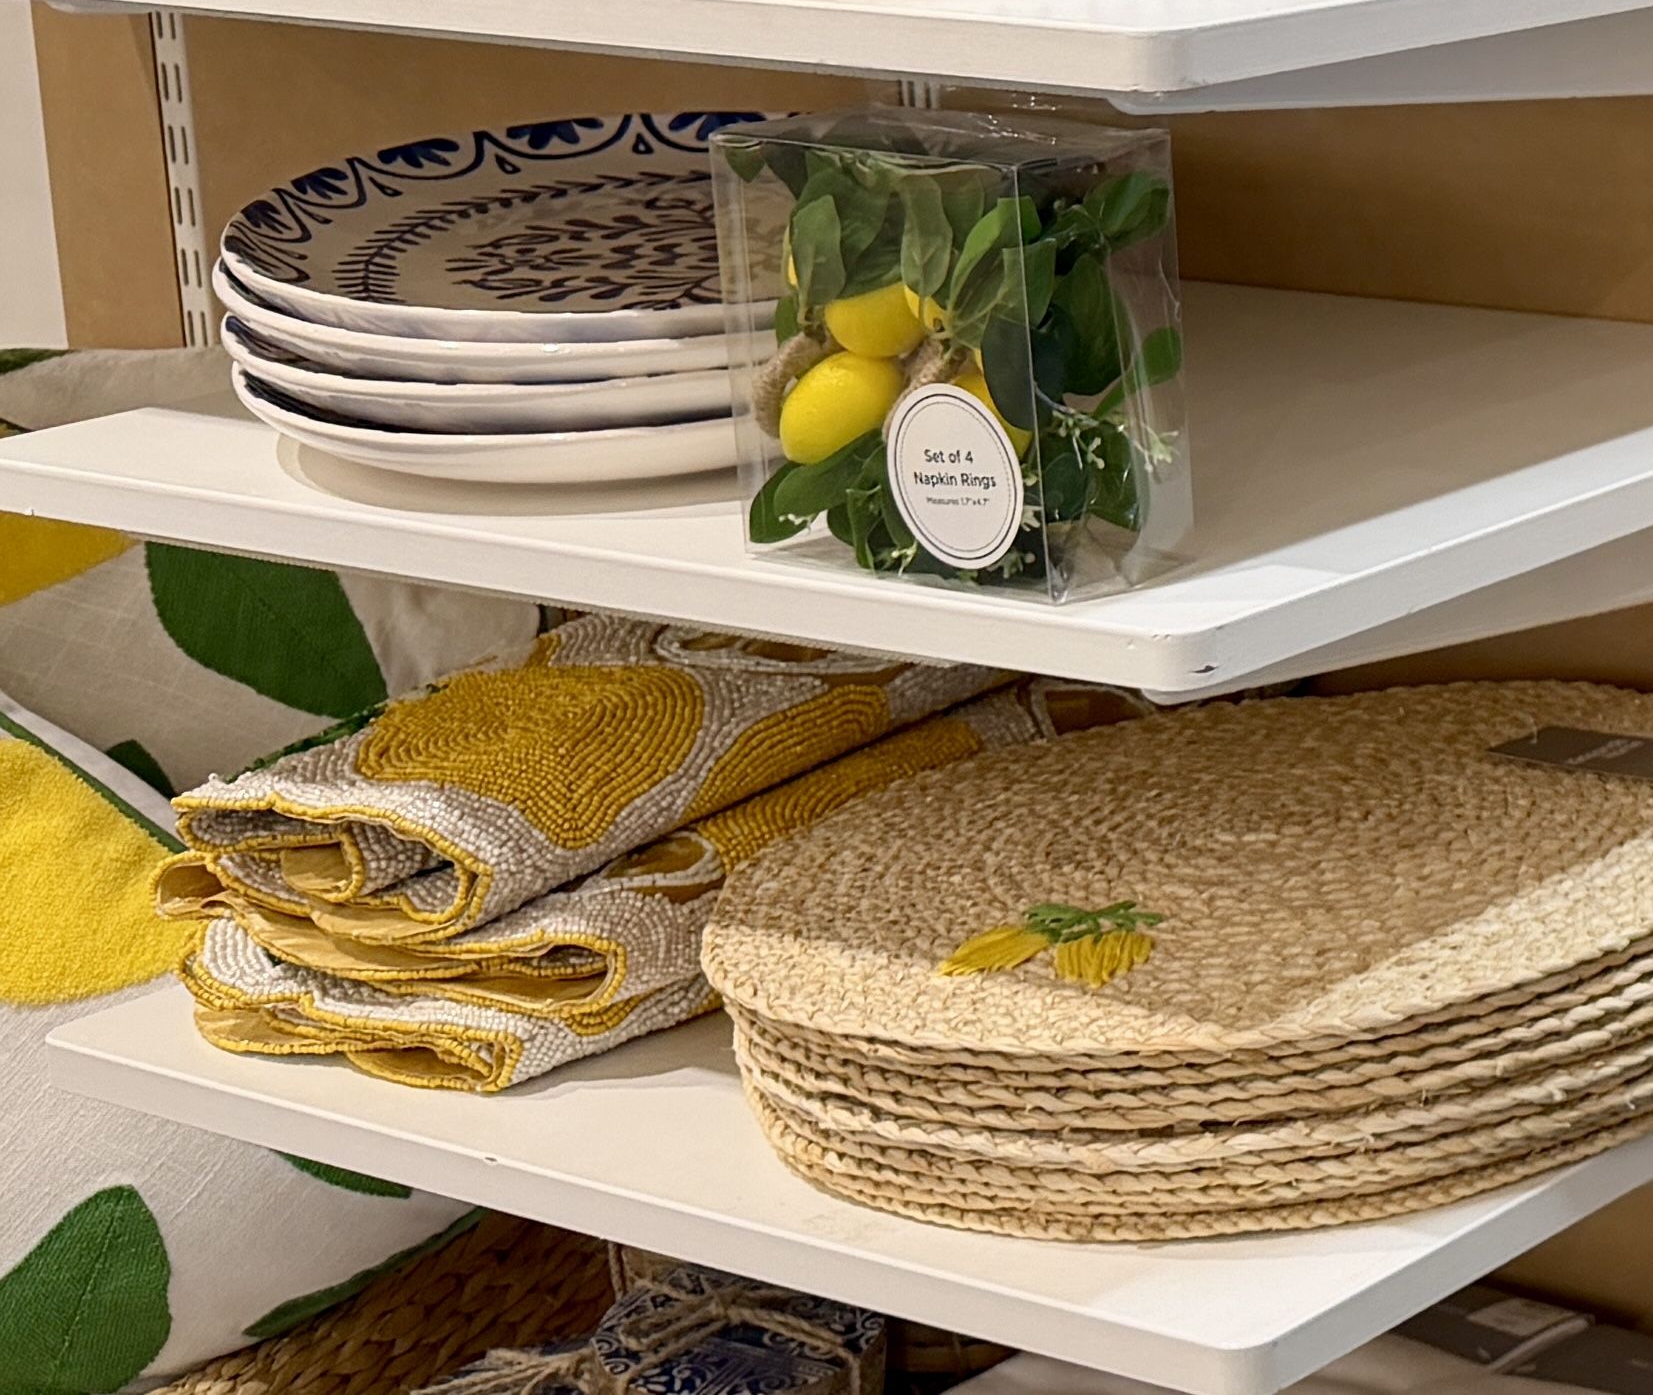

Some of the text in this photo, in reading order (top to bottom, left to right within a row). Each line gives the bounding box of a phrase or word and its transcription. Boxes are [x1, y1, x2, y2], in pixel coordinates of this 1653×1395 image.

[924, 449, 974, 464] Set of 4
[913, 471, 997, 490] Napkin Rings
